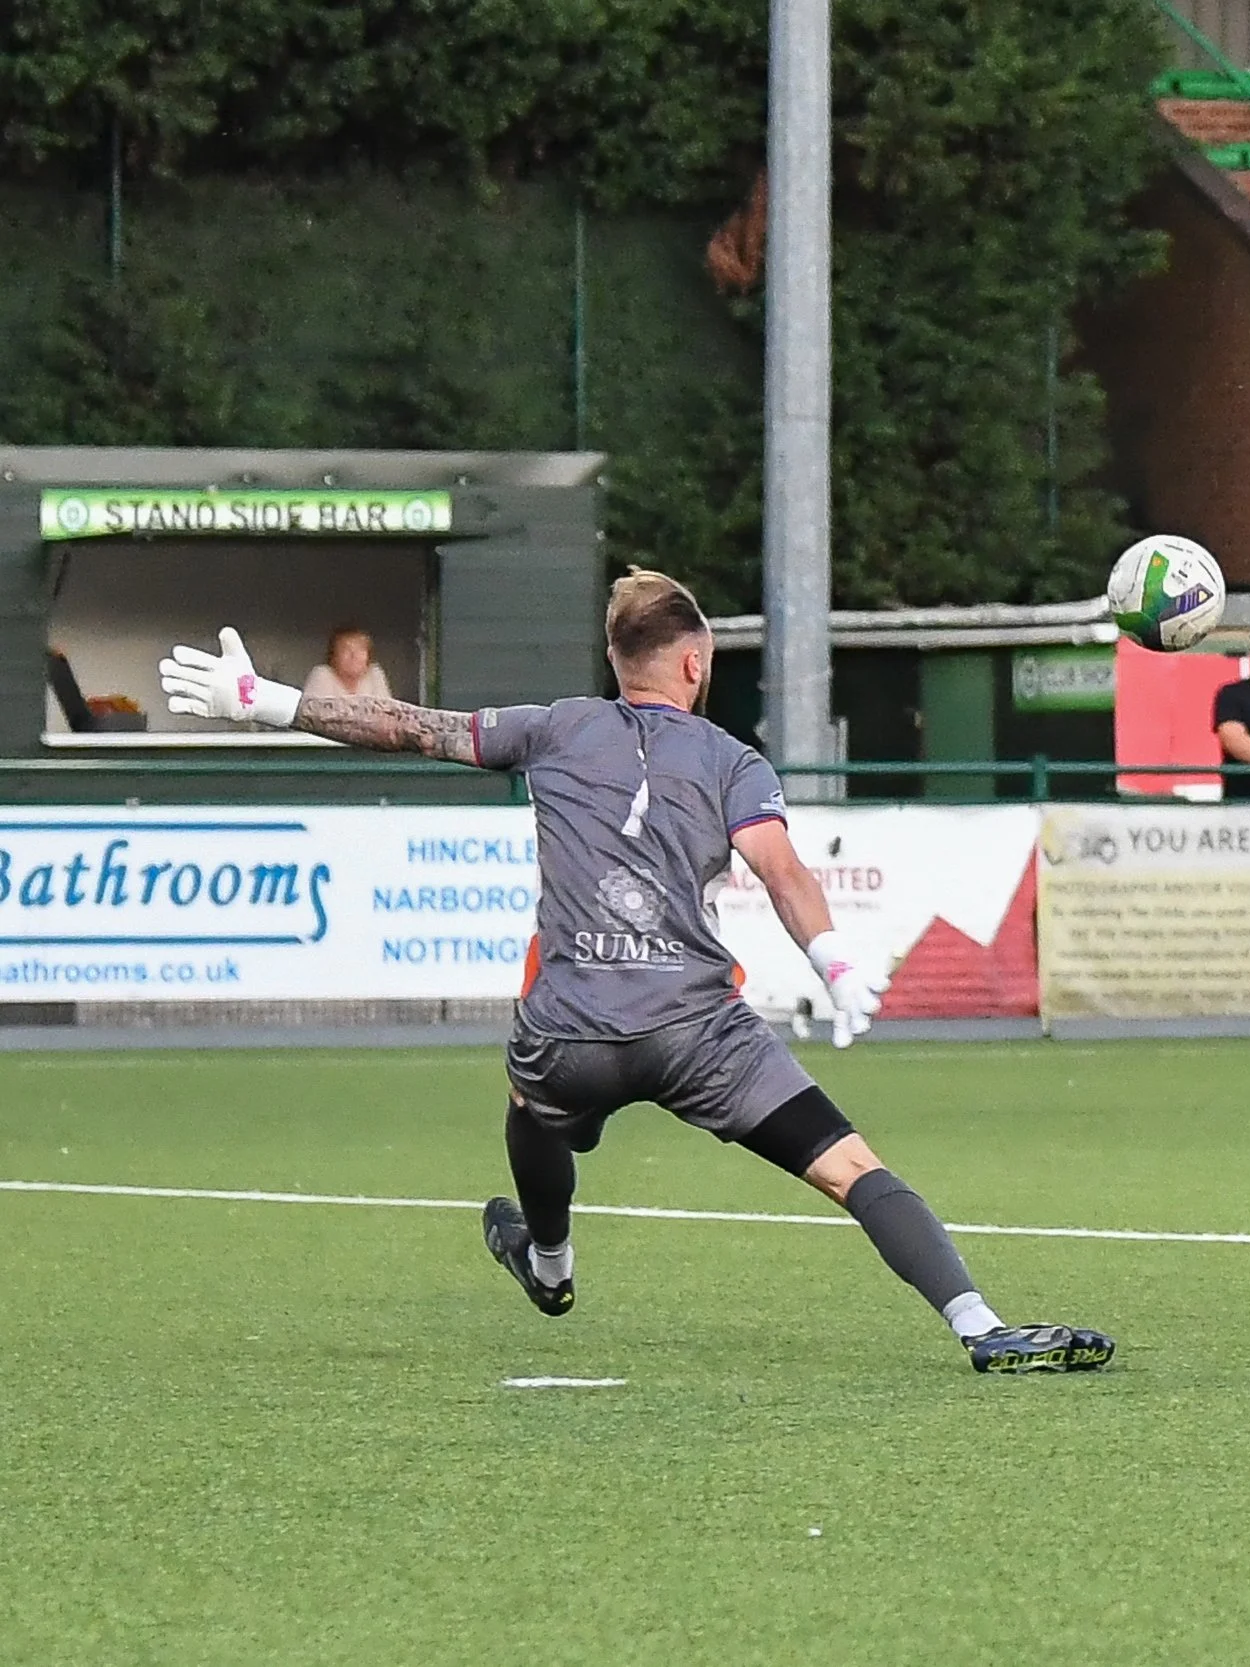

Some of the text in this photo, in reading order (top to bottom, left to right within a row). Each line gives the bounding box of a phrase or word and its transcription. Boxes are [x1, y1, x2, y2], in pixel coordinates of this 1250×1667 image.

[104, 499, 388, 533] STAND SIDE BAR
[407, 837, 536, 865] HINCKLE
[1127, 826, 1187, 852] YOU
[1198, 826, 1250, 852] ARE
[372, 885, 535, 913] NARBORO
